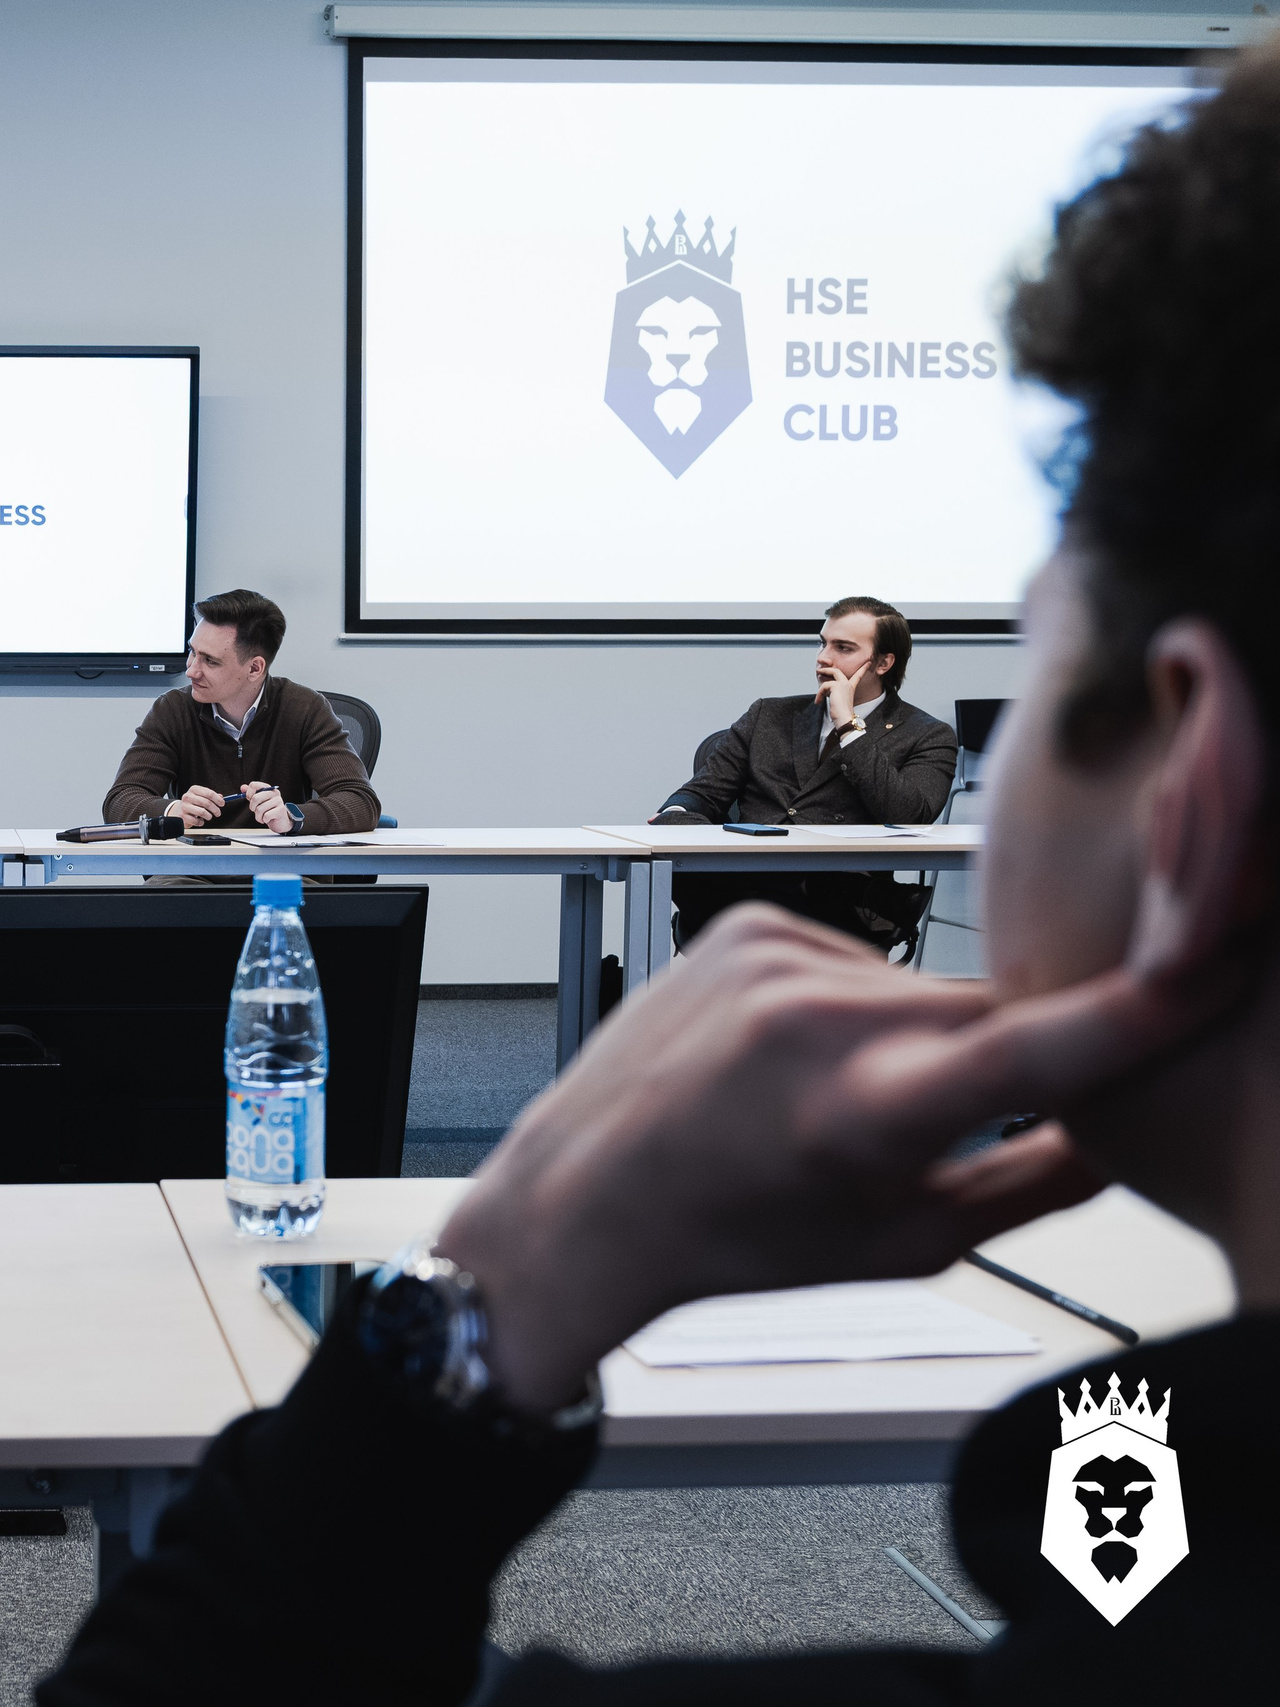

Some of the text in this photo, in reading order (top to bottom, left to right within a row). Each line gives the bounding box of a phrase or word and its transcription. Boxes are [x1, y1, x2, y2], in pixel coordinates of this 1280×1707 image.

[786, 278, 869, 316] HSE
[785, 341, 997, 379] BUSINESS
[783, 404, 899, 442] CLUB
